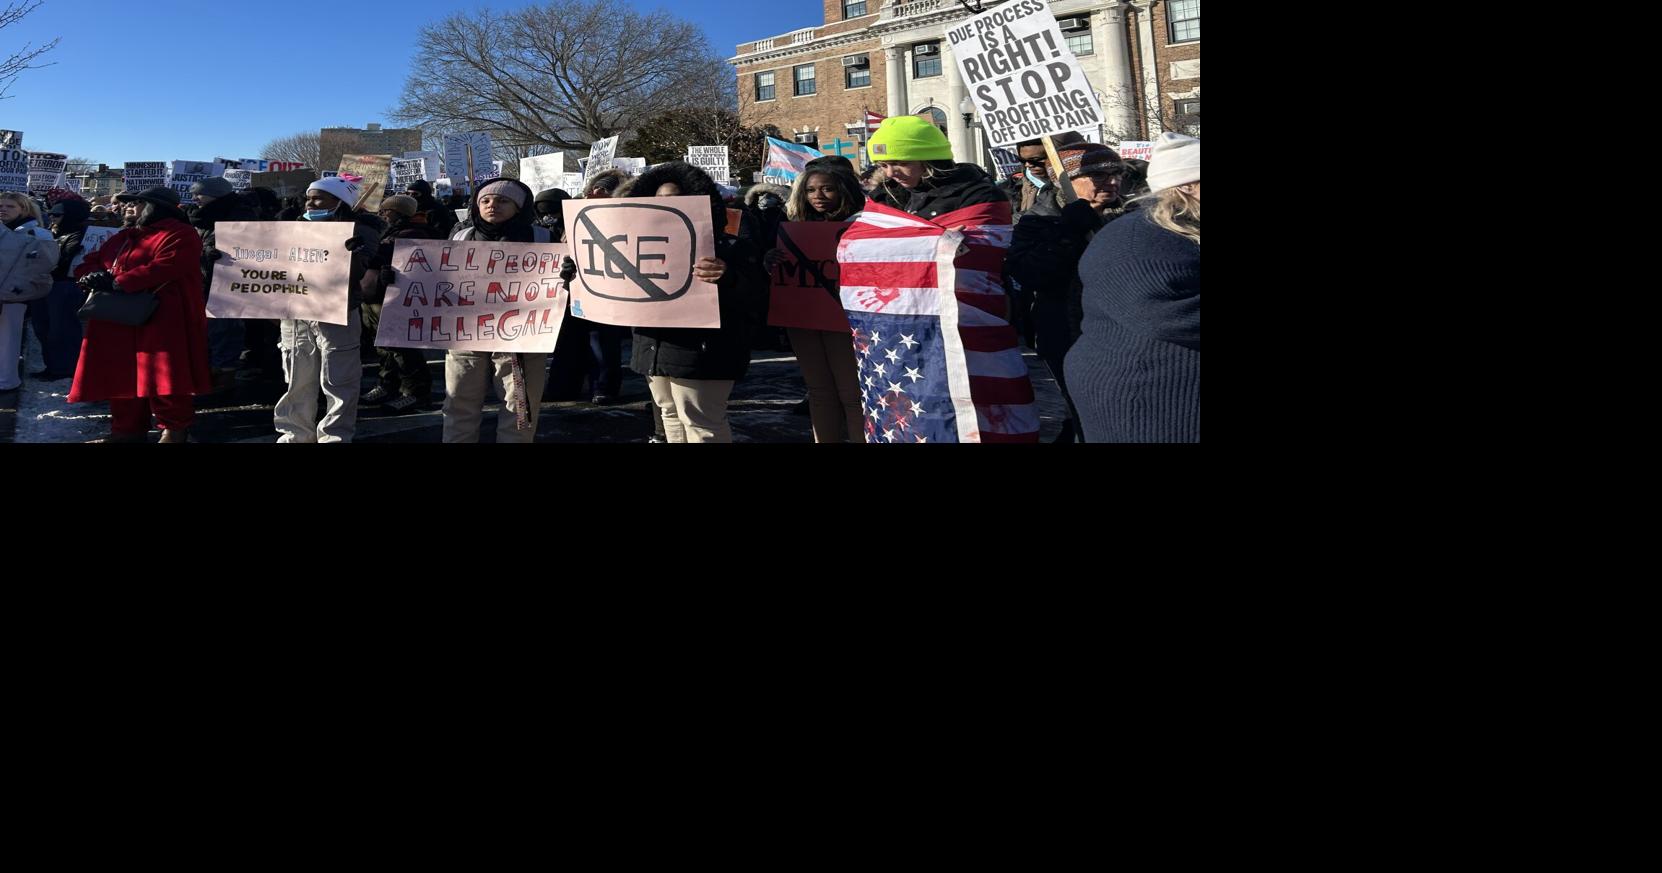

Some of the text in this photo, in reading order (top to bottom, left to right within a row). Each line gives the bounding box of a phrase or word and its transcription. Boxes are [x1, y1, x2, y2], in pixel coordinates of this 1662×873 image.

[948, 1, 1044, 45] DUE PROCESS
[978, 25, 1017, 51] IS A
[962, 29, 1061, 84] RIGHT!
[976, 61, 1071, 112] STOP
[984, 89, 1090, 130] PROFITING
[991, 107, 1099, 144] OFF OUR PAIN
[0, 149, 28, 161] TOP
[692, 157, 725, 165] IS GUILTY
[288, 248, 329, 263] ALIEN?
[404, 247, 562, 274] ALL PEOPL
[582, 234, 669, 280] ICE
[231, 283, 308, 295] PEDOPHILE
[297, 272, 305, 282] A
[403, 278, 564, 307] ARE NOT
